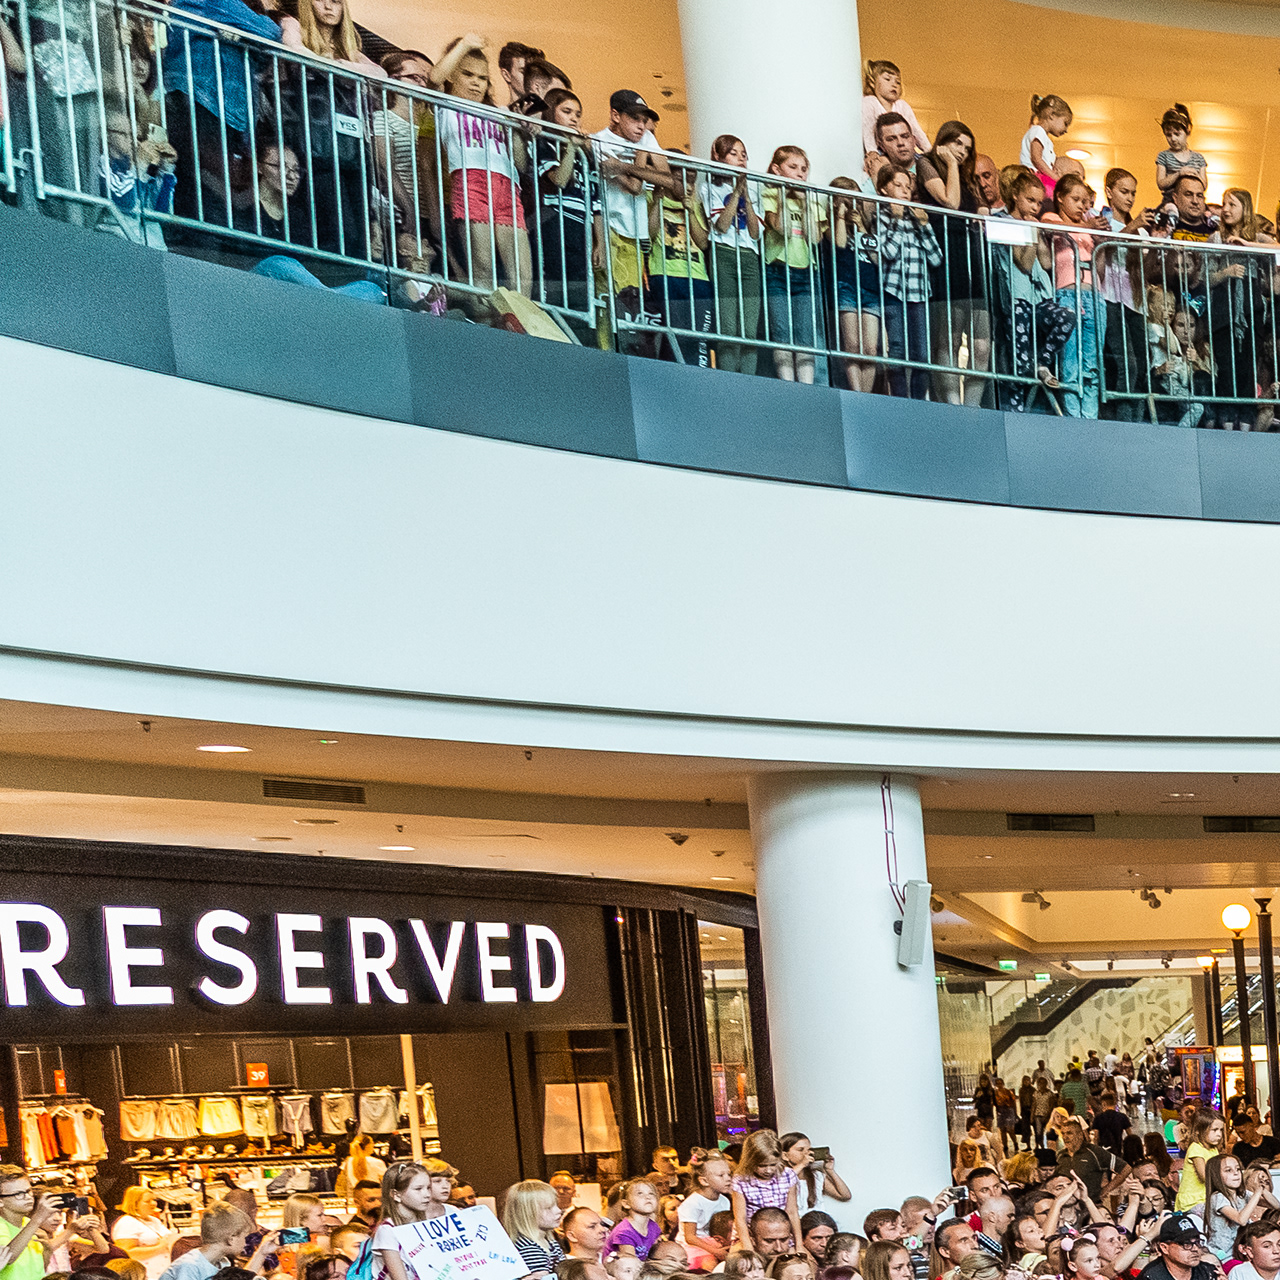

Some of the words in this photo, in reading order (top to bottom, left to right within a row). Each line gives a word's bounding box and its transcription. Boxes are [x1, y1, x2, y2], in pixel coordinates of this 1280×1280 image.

[0, 901, 566, 1007] RESERVED
[251, 1070, 267, 1081] 39
[421, 1213, 466, 1240] LOVE
